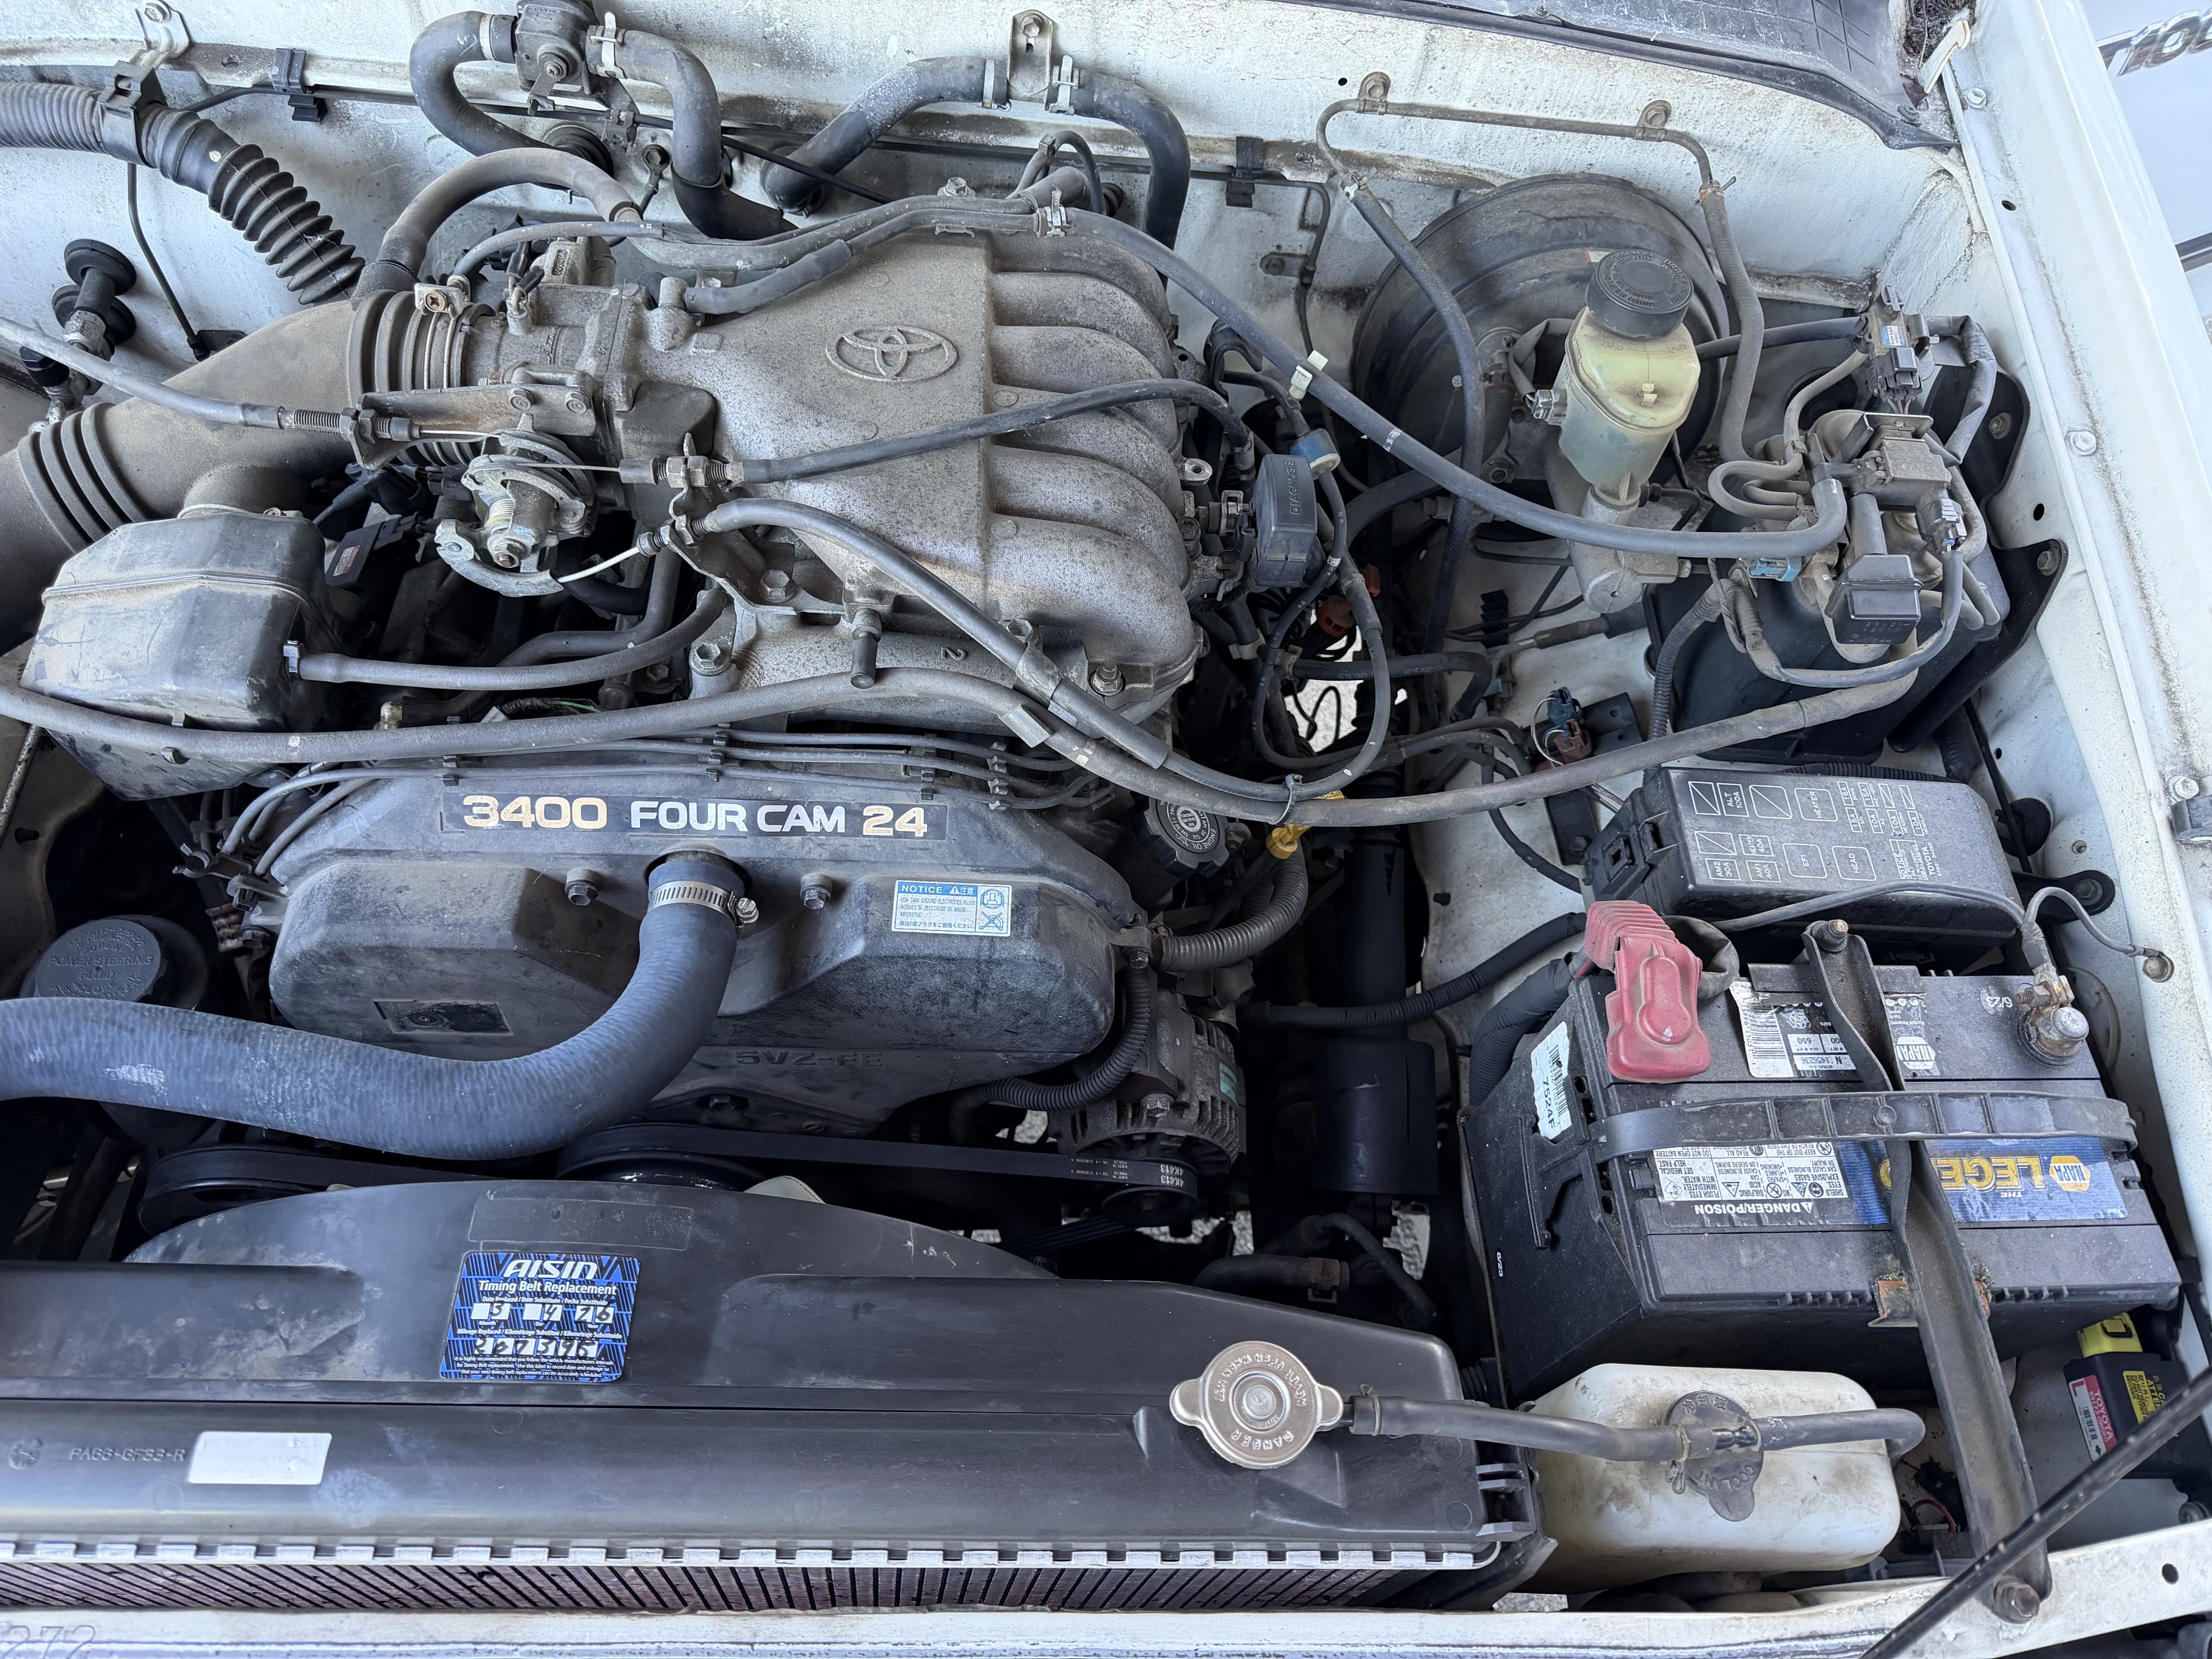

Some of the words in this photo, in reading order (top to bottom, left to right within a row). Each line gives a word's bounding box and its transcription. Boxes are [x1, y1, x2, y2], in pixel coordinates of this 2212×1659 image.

[1285, 462, 1300, 515] DIAGNOSIS
[1725, 792, 1734, 807] ALT
[1733, 792, 1743, 809] 100A
[1808, 791, 1823, 819] HEATER
[463, 795, 608, 830] 3400
[630, 800, 749, 833] FOUR
[757, 805, 846, 834] CAM
[861, 805, 928, 837] 24
[1870, 814, 1879, 828] 10A
[1911, 816, 1920, 830] 10A
[1202, 828, 1217, 850] ENGINE
[1747, 836, 1757, 854] HEATER
[1757, 838, 1766, 854] 40A
[1713, 861, 1724, 878] AM2
[1723, 861, 1733, 878] 30A
[1801, 855, 1810, 867] EFI
[1849, 854, 1860, 874] HEAD
[1894, 853, 1907, 879] NOTICE
[1922, 846, 1936, 876] TOYOTA
[1755, 864, 1764, 879] AM1
[1763, 864, 1772, 880] 40A
[902, 884, 943, 894] NOTICE
[49, 956, 92, 967] POWER
[94, 955, 154, 967] STEERING
[80, 970, 116, 981] FLUID
[1985, 996, 2013, 1008] 6/23
[735, 1049, 883, 1068] 5VZ-FE
[1899, 1045, 1930, 1061] NAPA
[1543, 1077, 1555, 1128] 7524F
[1160, 1164, 1184, 1176] 4K413
[2054, 1164, 2086, 1183] NAPA
[1161, 1175, 1184, 1187] 4K413
[1695, 1202, 1802, 1214] DANGER/POISON
[503, 1259, 598, 1279] AISIN
[479, 1280, 517, 1293] Timing
[519, 1282, 541, 1292] Belt
[544, 1281, 617, 1295] Replacement
[1253, 1352, 1285, 1371] OPEN
[1214, 1379, 1228, 1402] HOT
[2071, 1379, 2084, 1396] L
[2094, 1390, 2113, 1441] TOYOTA
